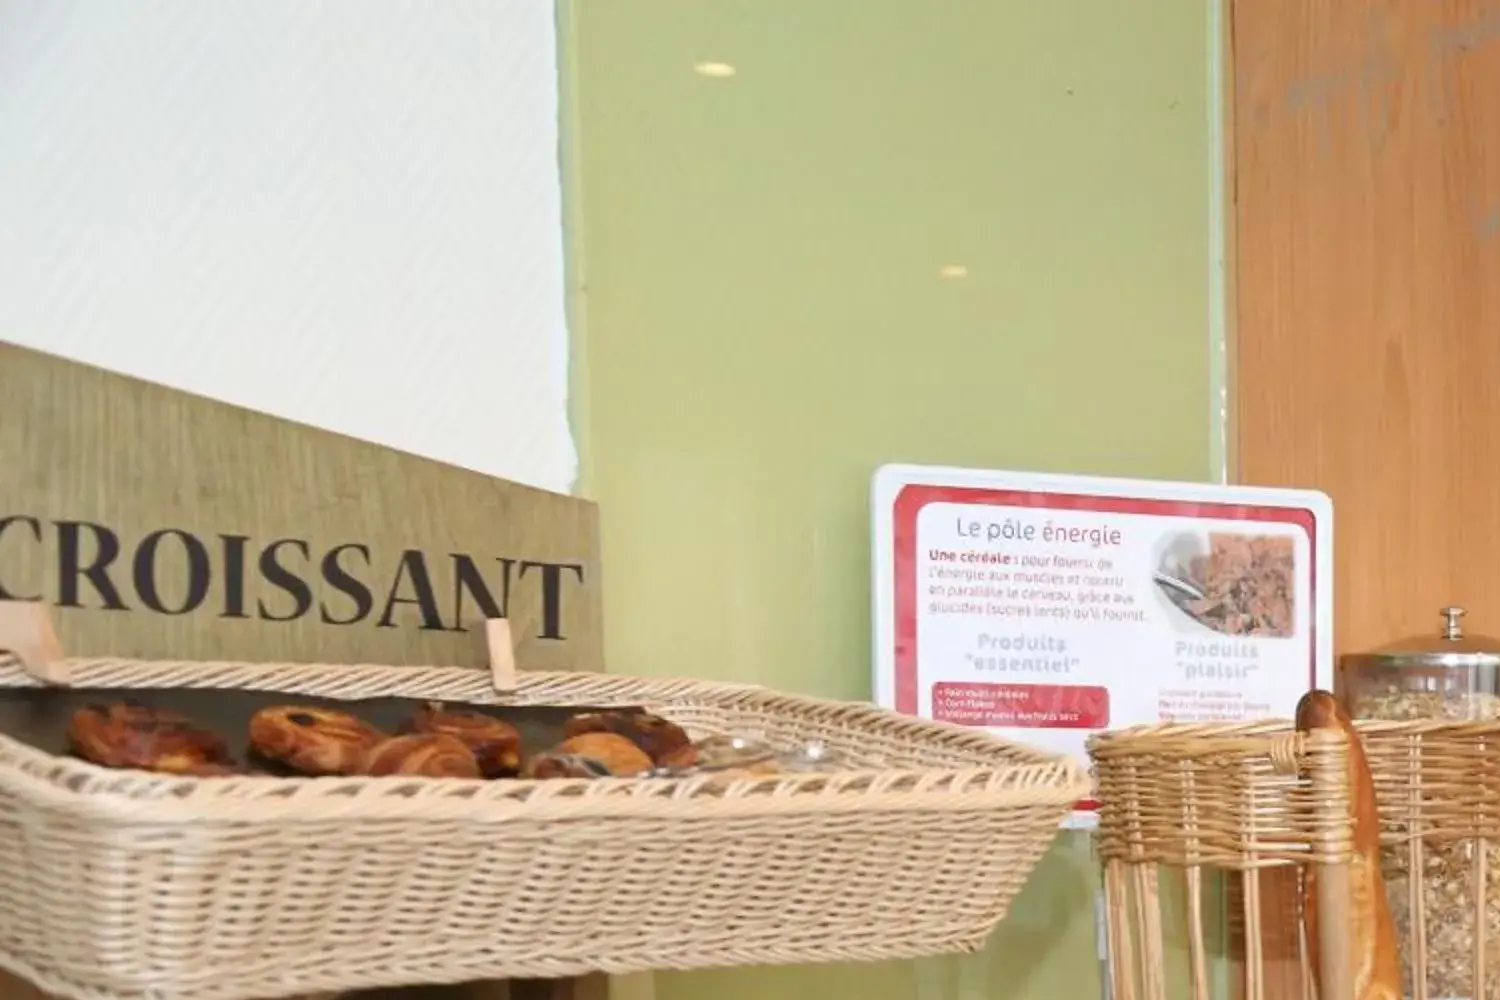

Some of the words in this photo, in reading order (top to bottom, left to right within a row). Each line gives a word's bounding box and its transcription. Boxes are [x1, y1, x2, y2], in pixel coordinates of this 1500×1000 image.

[956, 516, 982, 538] Le
[987, 518, 1036, 541] pôle
[1042, 520, 1122, 547] énergie
[928, 549, 956, 562] Une
[1021, 556, 1050, 569] pour
[0, 515, 584, 641] CROISSANT
[977, 632, 1067, 652] Produits
